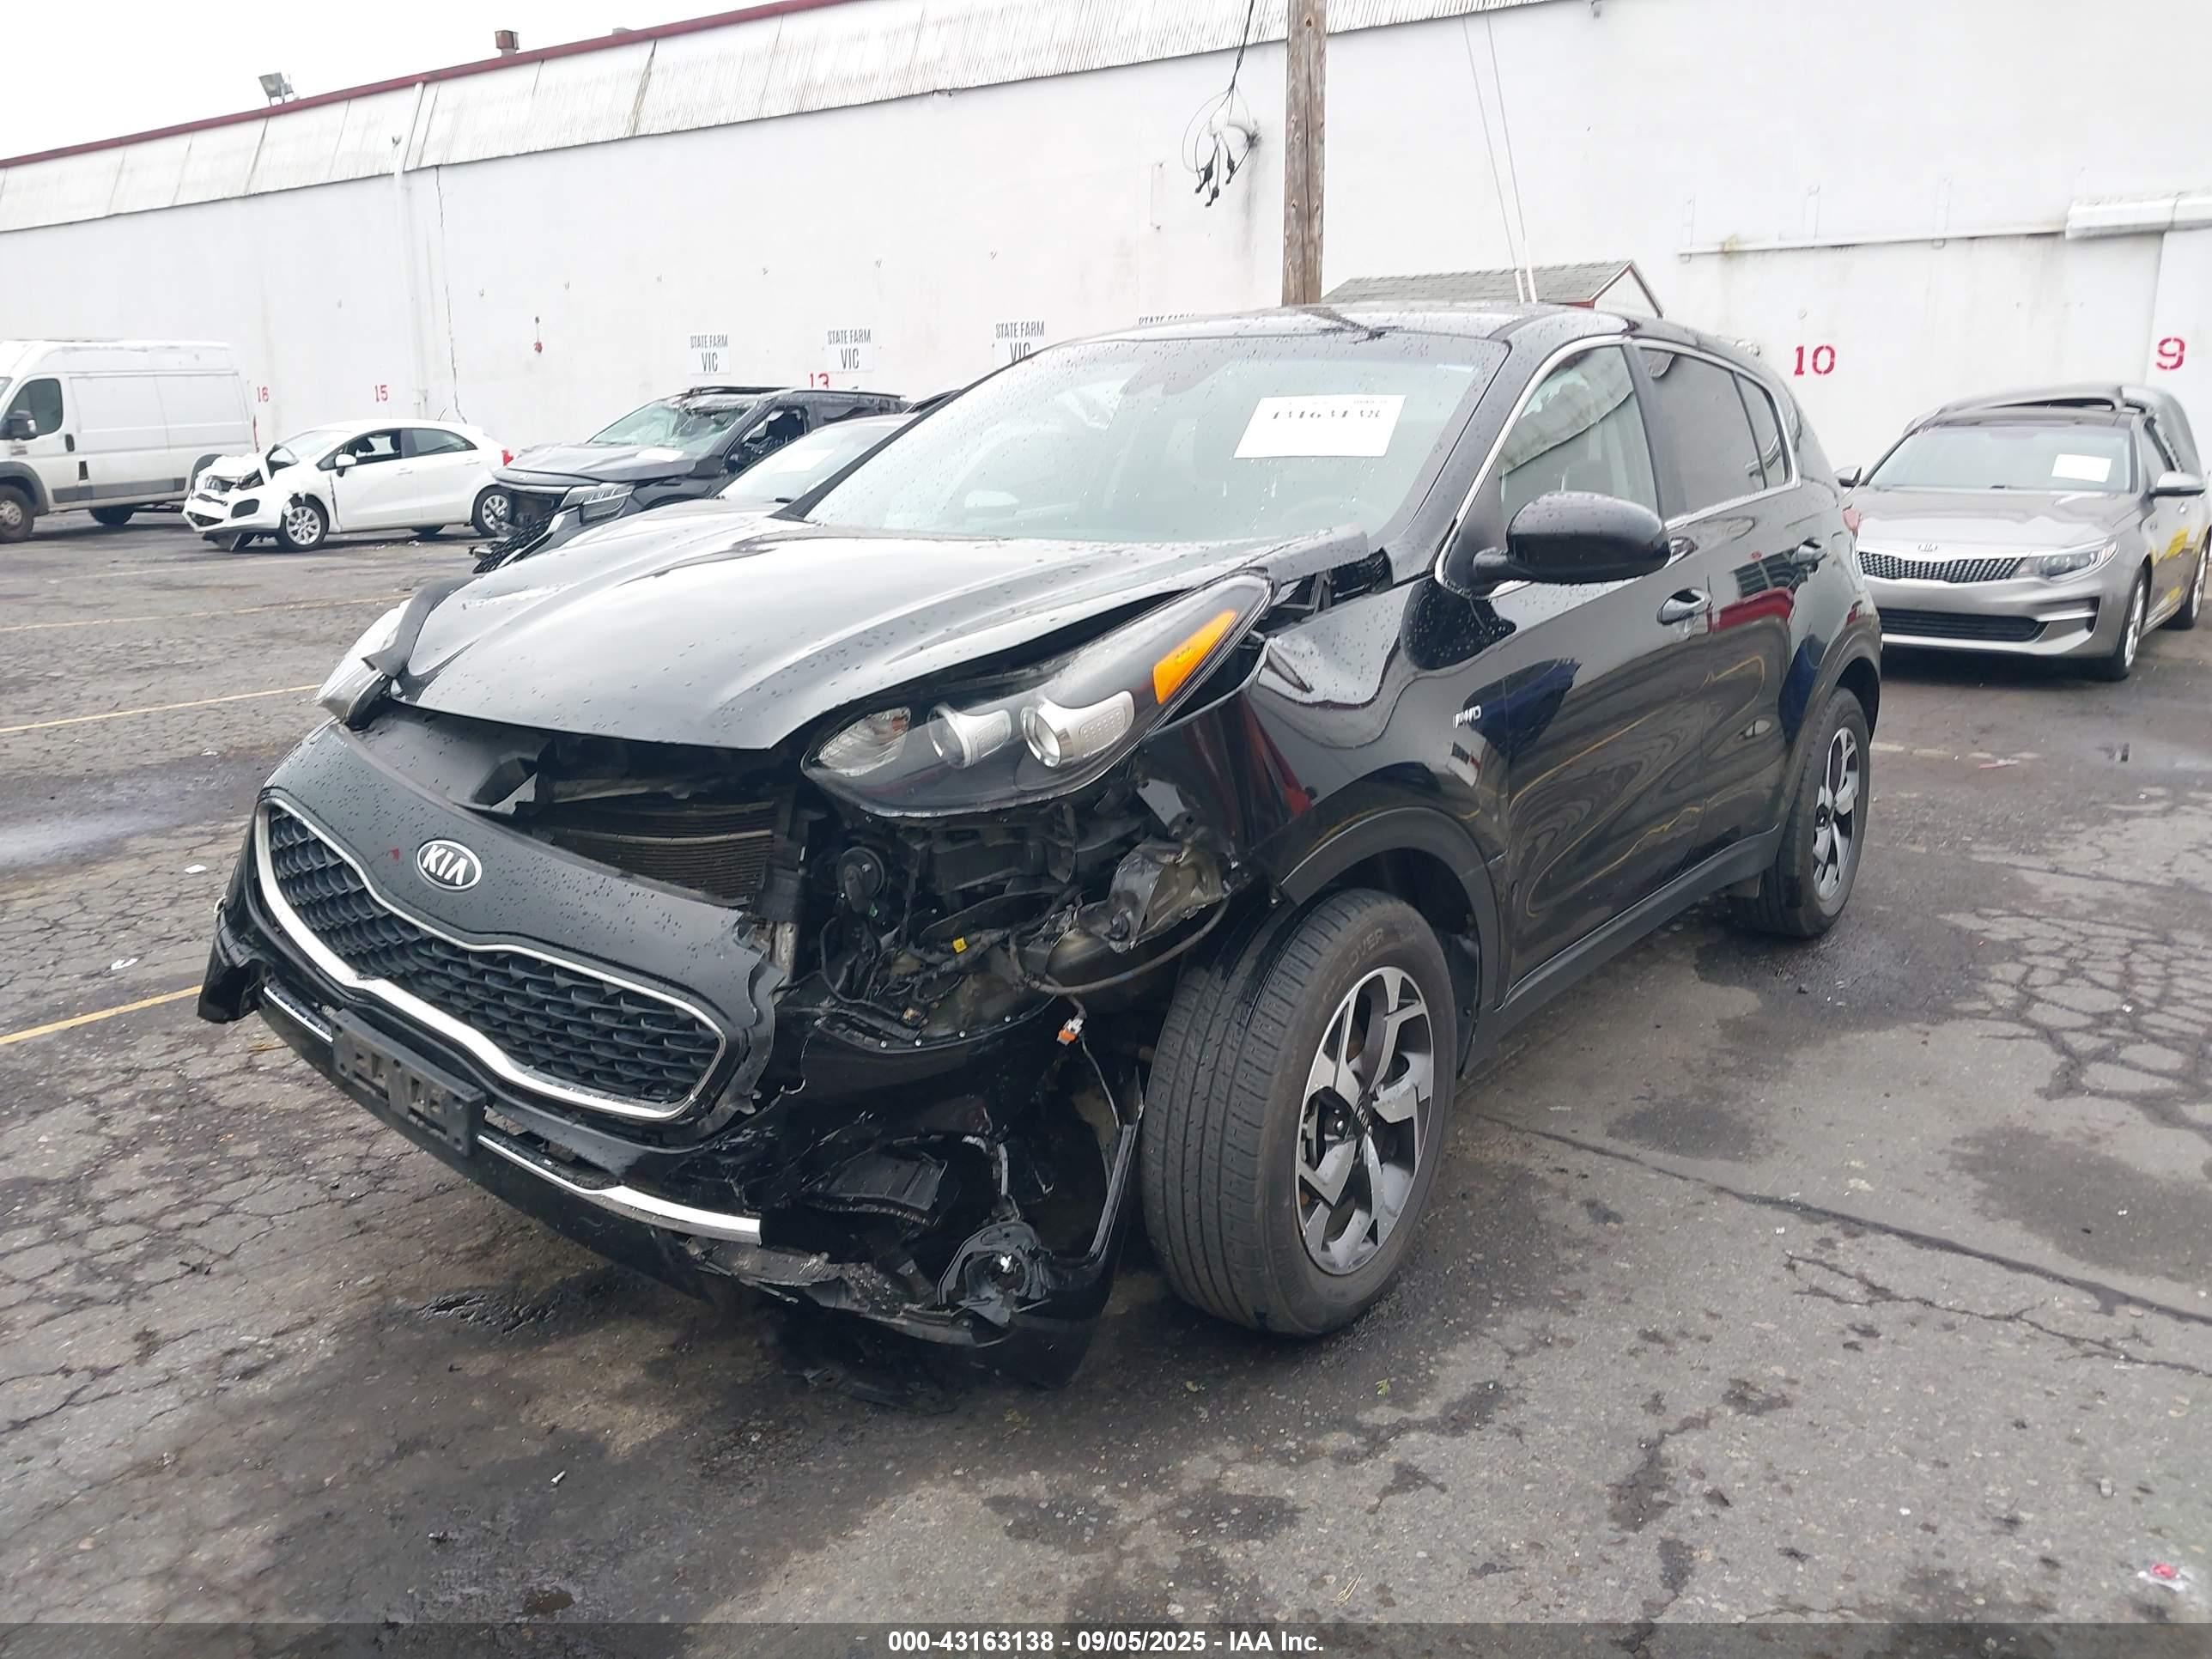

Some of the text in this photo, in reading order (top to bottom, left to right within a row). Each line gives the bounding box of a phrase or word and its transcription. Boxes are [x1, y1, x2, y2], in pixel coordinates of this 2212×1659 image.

[827, 328, 872, 345] STATE FARM
[995, 320, 1045, 338] STATE FARM
[690, 333, 728, 349] STATE FARM
[701, 351, 719, 372] VIC
[841, 348, 860, 369] VIC
[1794, 345, 1836, 375] 10
[2156, 337, 2185, 370] 9
[374, 384, 389, 403] 15
[422, 844, 469, 886] KIA
